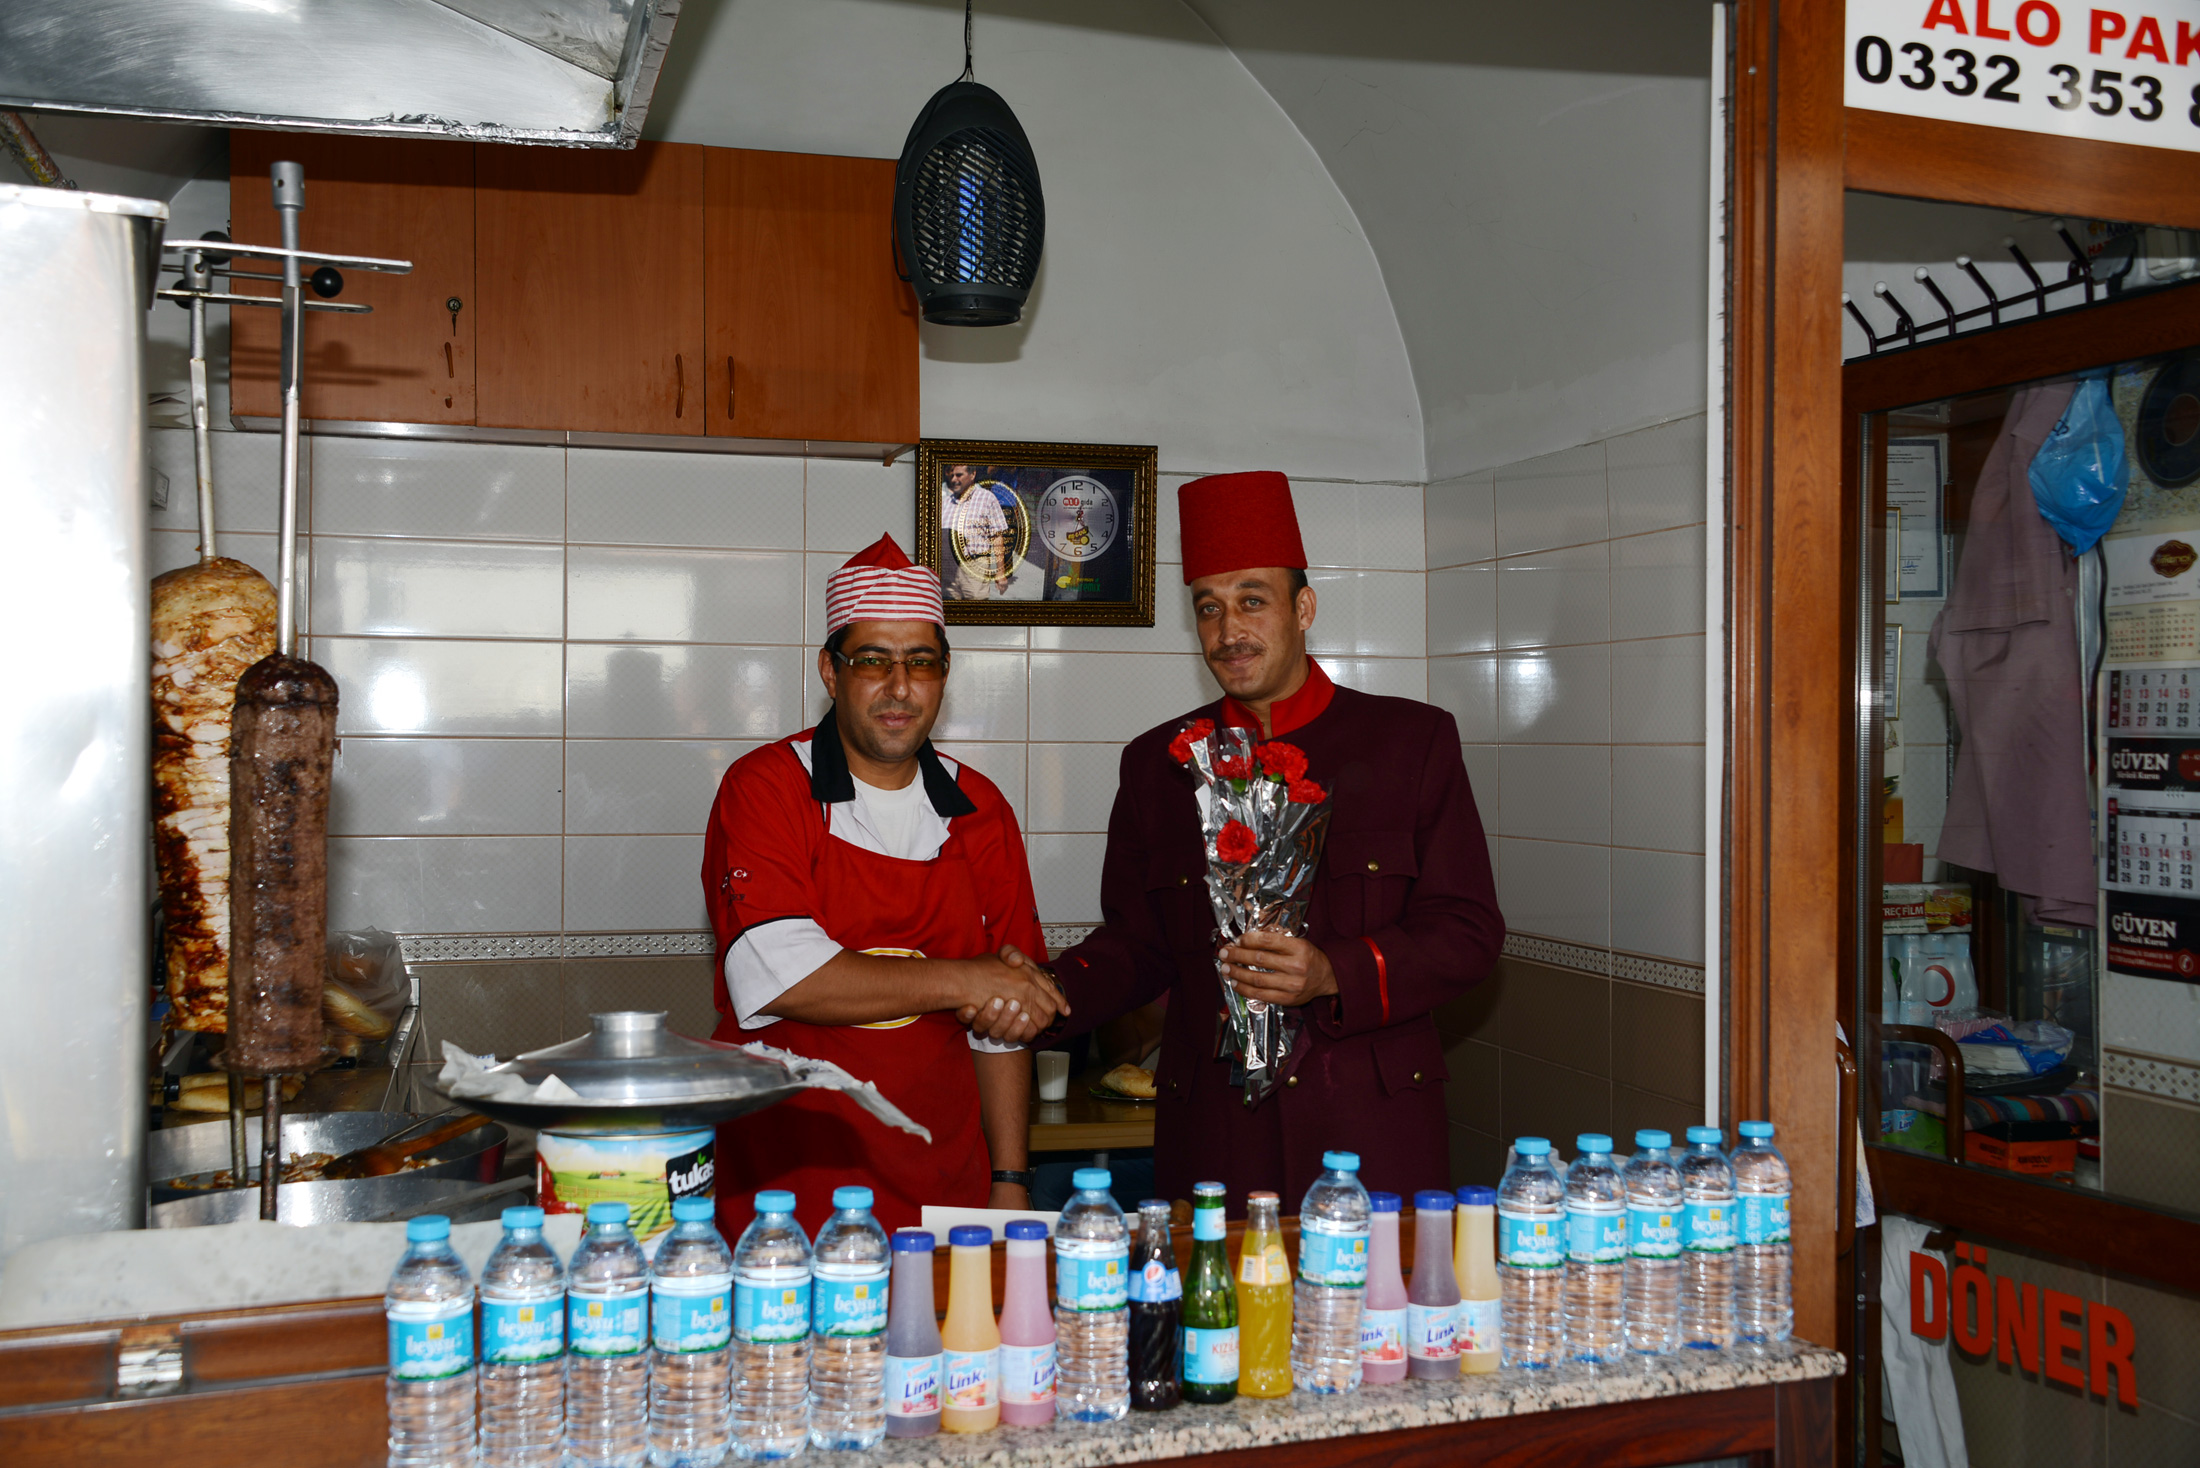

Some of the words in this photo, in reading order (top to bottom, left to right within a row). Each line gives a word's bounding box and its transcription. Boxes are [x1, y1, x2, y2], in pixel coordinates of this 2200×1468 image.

[1922, 0, 2061, 47] ALO
[1855, 35, 2021, 103] 0332
[2046, 64, 2164, 122] 353
[1072, 481, 1084, 490] 12
[1101, 499, 1109, 507] 2
[1105, 514, 1113, 523] 3
[1048, 531, 1056, 539] 8
[1101, 531, 1109, 539] 4
[1074, 547, 1082, 556] 6
[1091, 543, 1098, 552] 5
[2111, 748, 2170, 771] GÜVEN
[2111, 912, 2177, 939] GÜVEN
[1427, 1322, 1455, 1343] Link
[1910, 1241, 2140, 1408] DÖNER
[1361, 1326, 1384, 1342] ink
[904, 1374, 937, 1399] Link
[950, 1370, 982, 1391] Link
